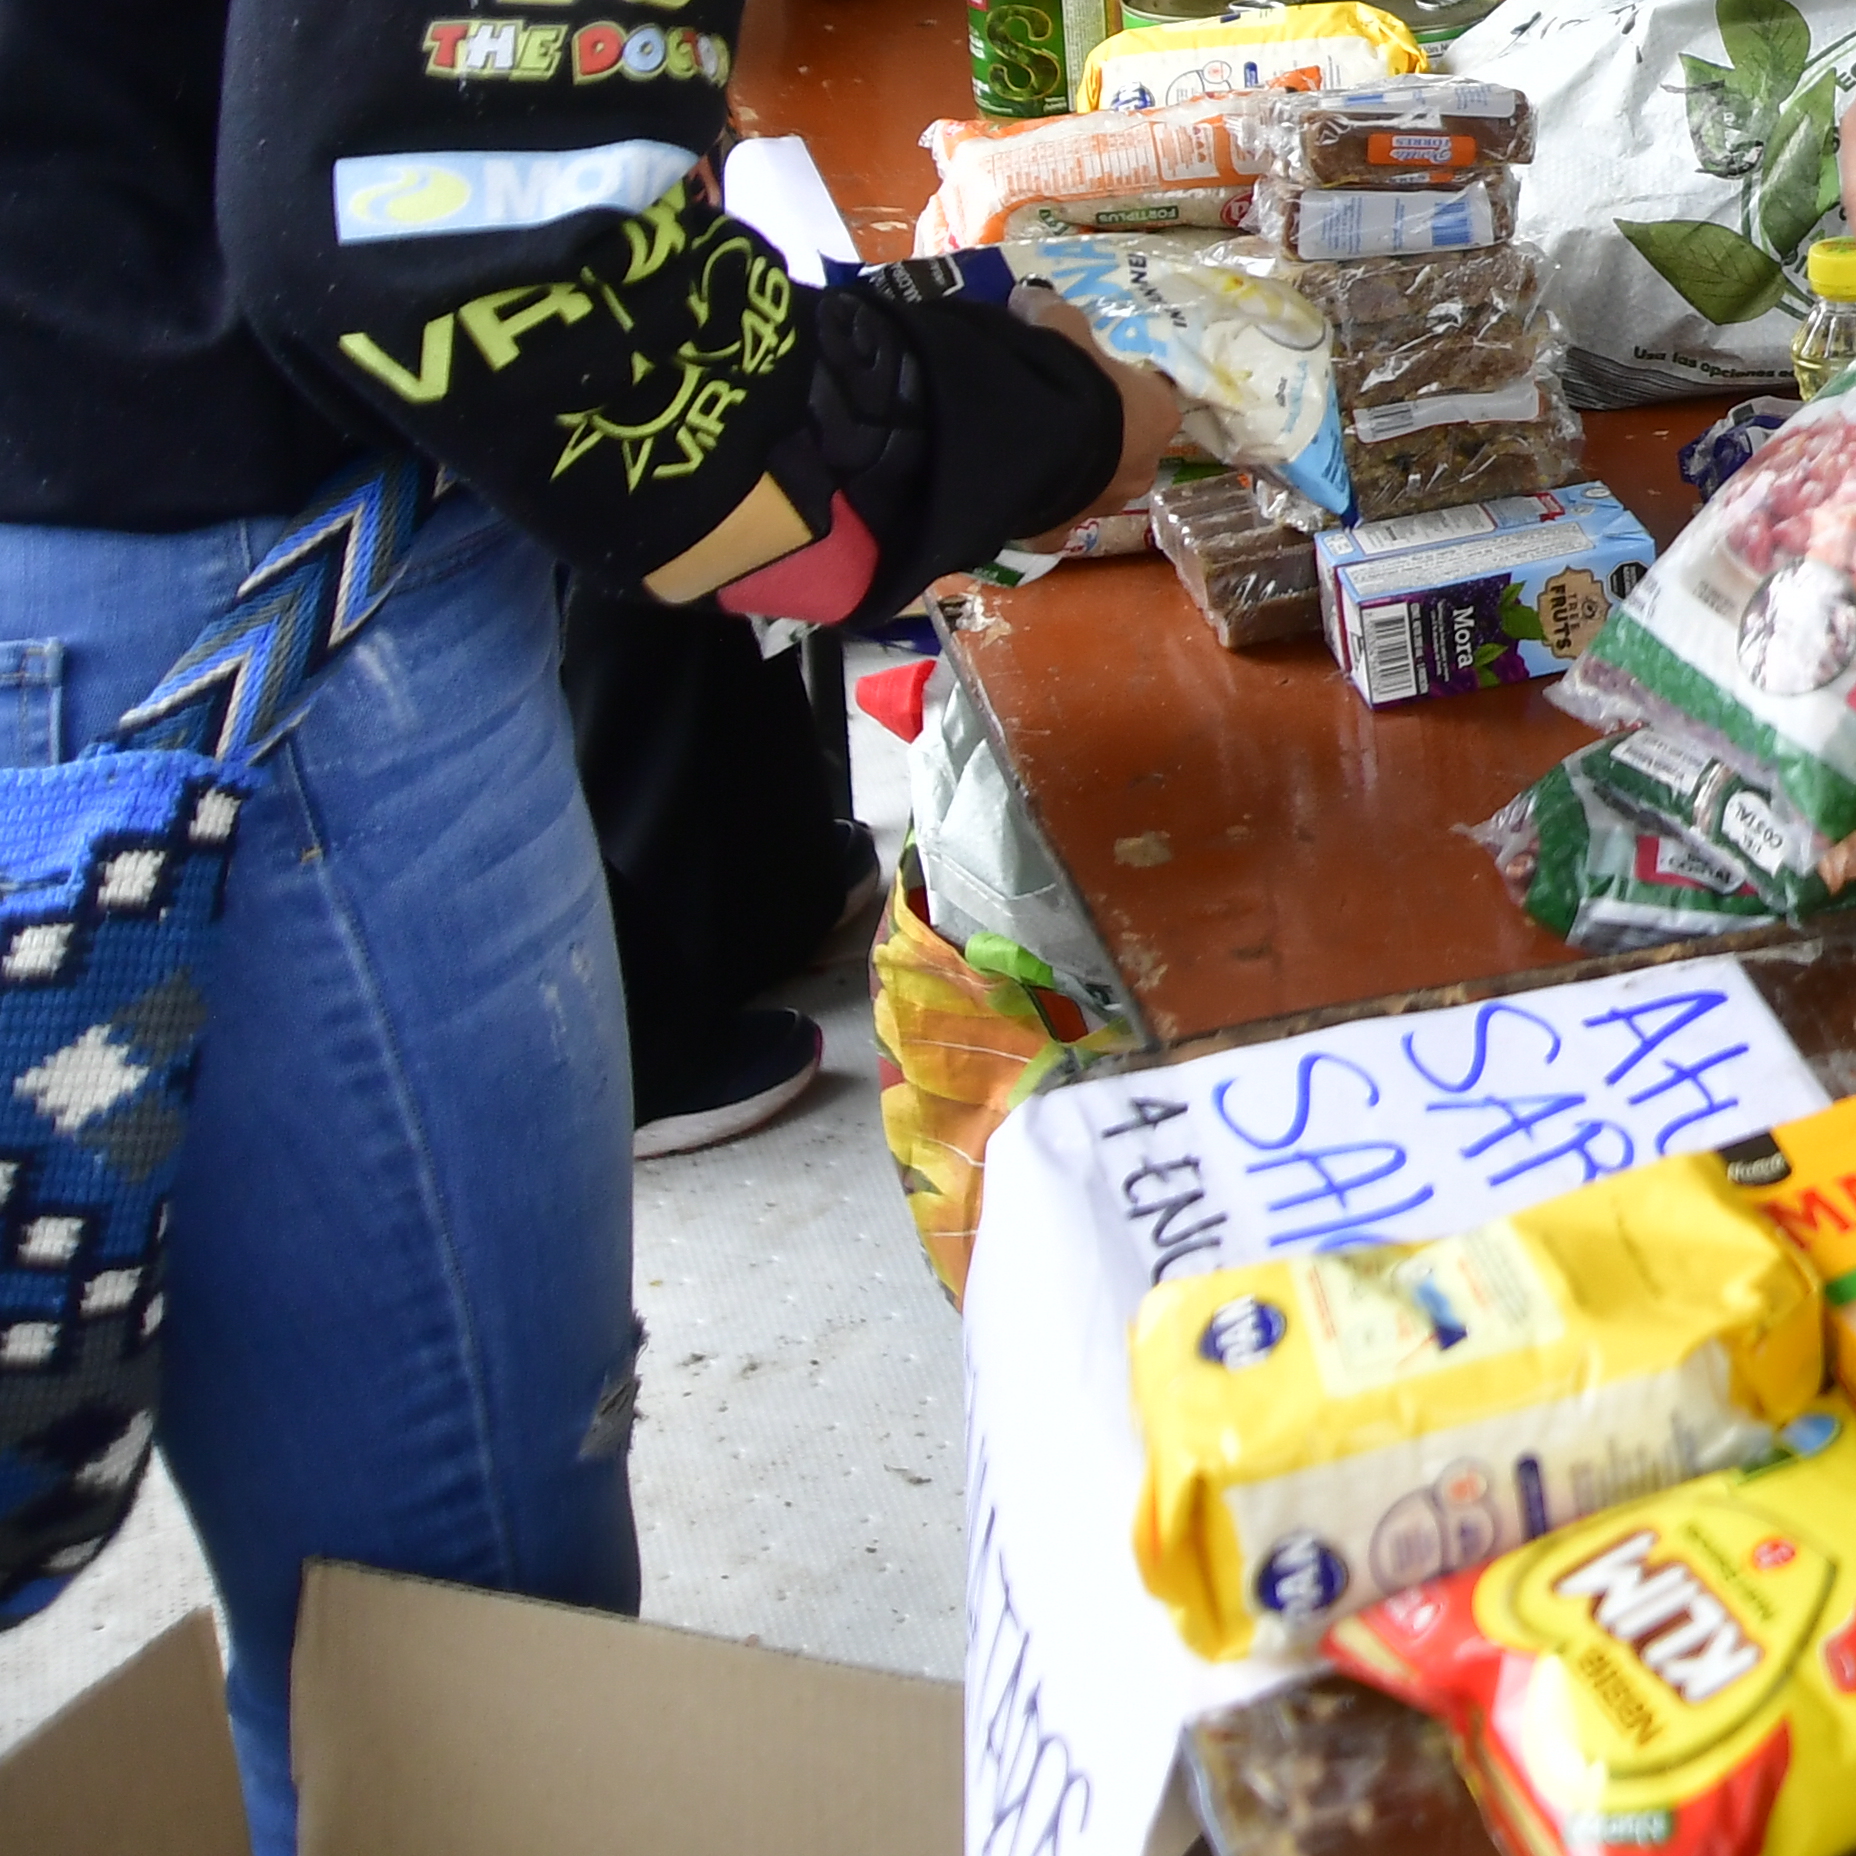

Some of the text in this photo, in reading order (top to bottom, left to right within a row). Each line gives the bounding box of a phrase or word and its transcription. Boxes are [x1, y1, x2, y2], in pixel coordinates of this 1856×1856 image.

[423, 18, 570, 83] THE
[1097, 207, 1178, 223] FORTIPLUS
[1634, 345, 1667, 361] Usa
[1672, 350, 1698, 368] las
[1699, 362, 1775, 378] opciones
[1452, 605, 1475, 670] Mora
[1549, 582, 1573, 651] FRUTS
[1565, 593, 1581, 631] TREE
[1734, 806, 1785, 851] COSTAL
[1554, 1530, 1763, 1704] KLIM
